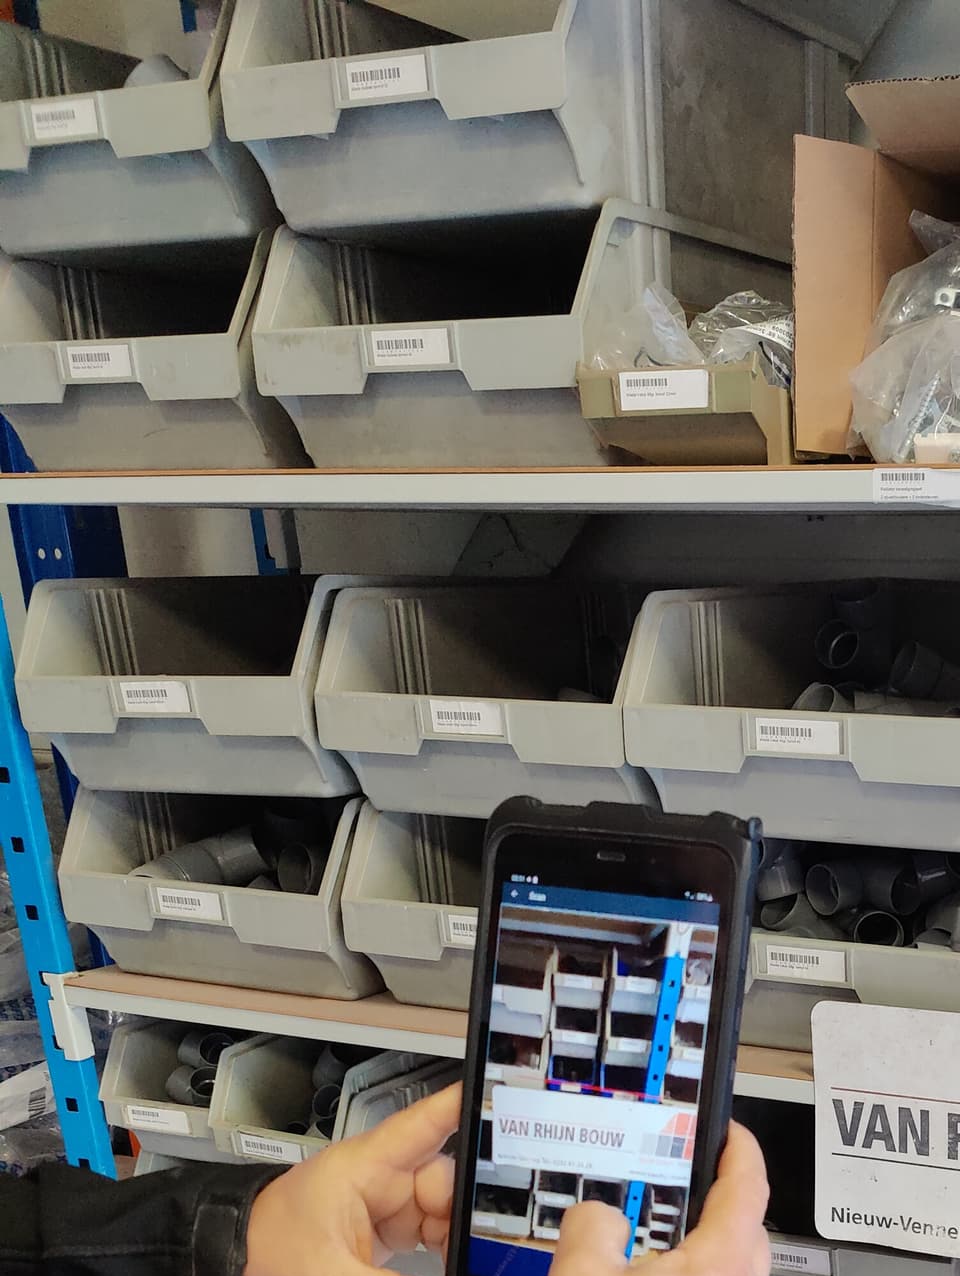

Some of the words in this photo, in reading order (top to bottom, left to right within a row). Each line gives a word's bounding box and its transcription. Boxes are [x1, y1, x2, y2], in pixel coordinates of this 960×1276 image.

[499, 1117, 529, 1137] VAN
[533, 1121, 575, 1143] RHIJN
[579, 1128, 625, 1148] BOUW
[831, 1098, 930, 1157] VAN
